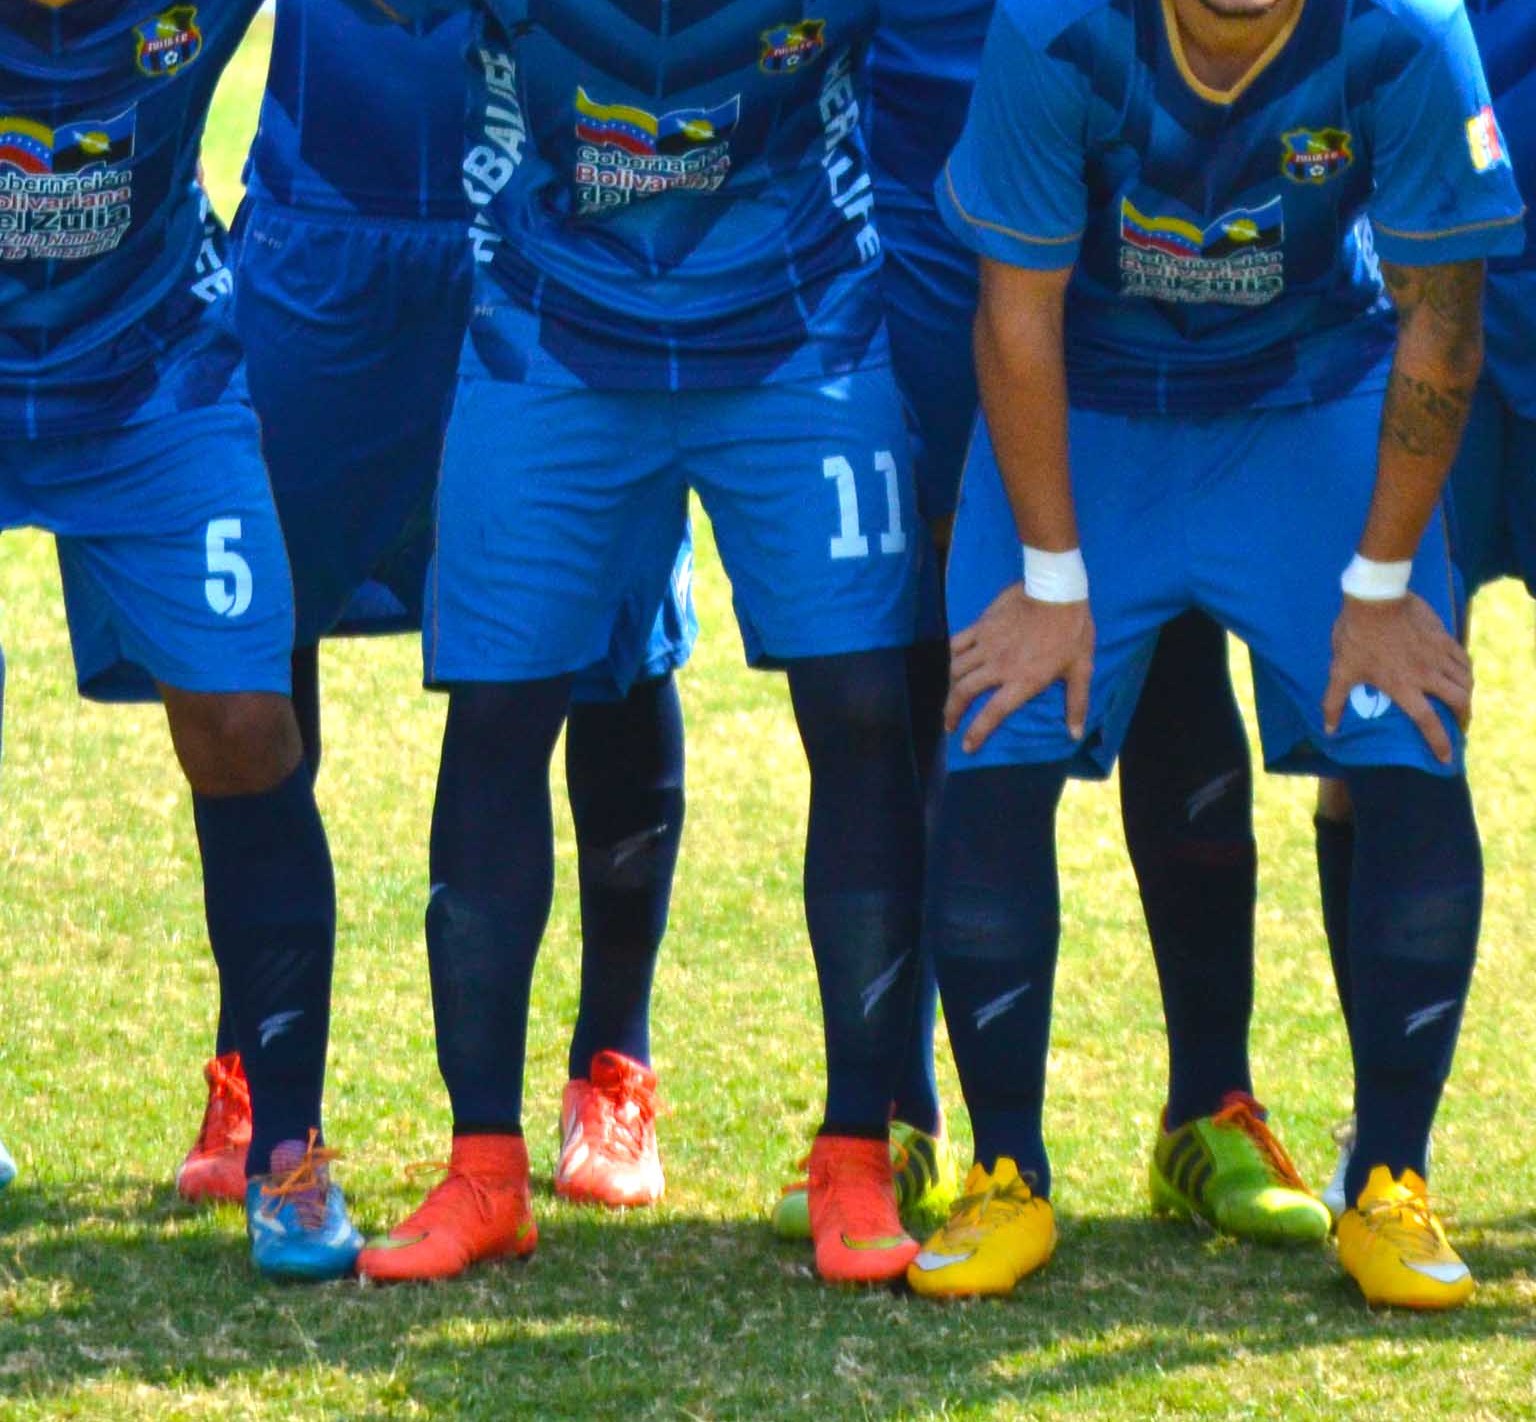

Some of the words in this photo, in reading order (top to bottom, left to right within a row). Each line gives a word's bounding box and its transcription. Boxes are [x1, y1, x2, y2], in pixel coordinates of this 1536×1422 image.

[31, 204, 131, 232] Zulia
[822, 450, 907, 560] 11
[204, 518, 254, 618] 5
